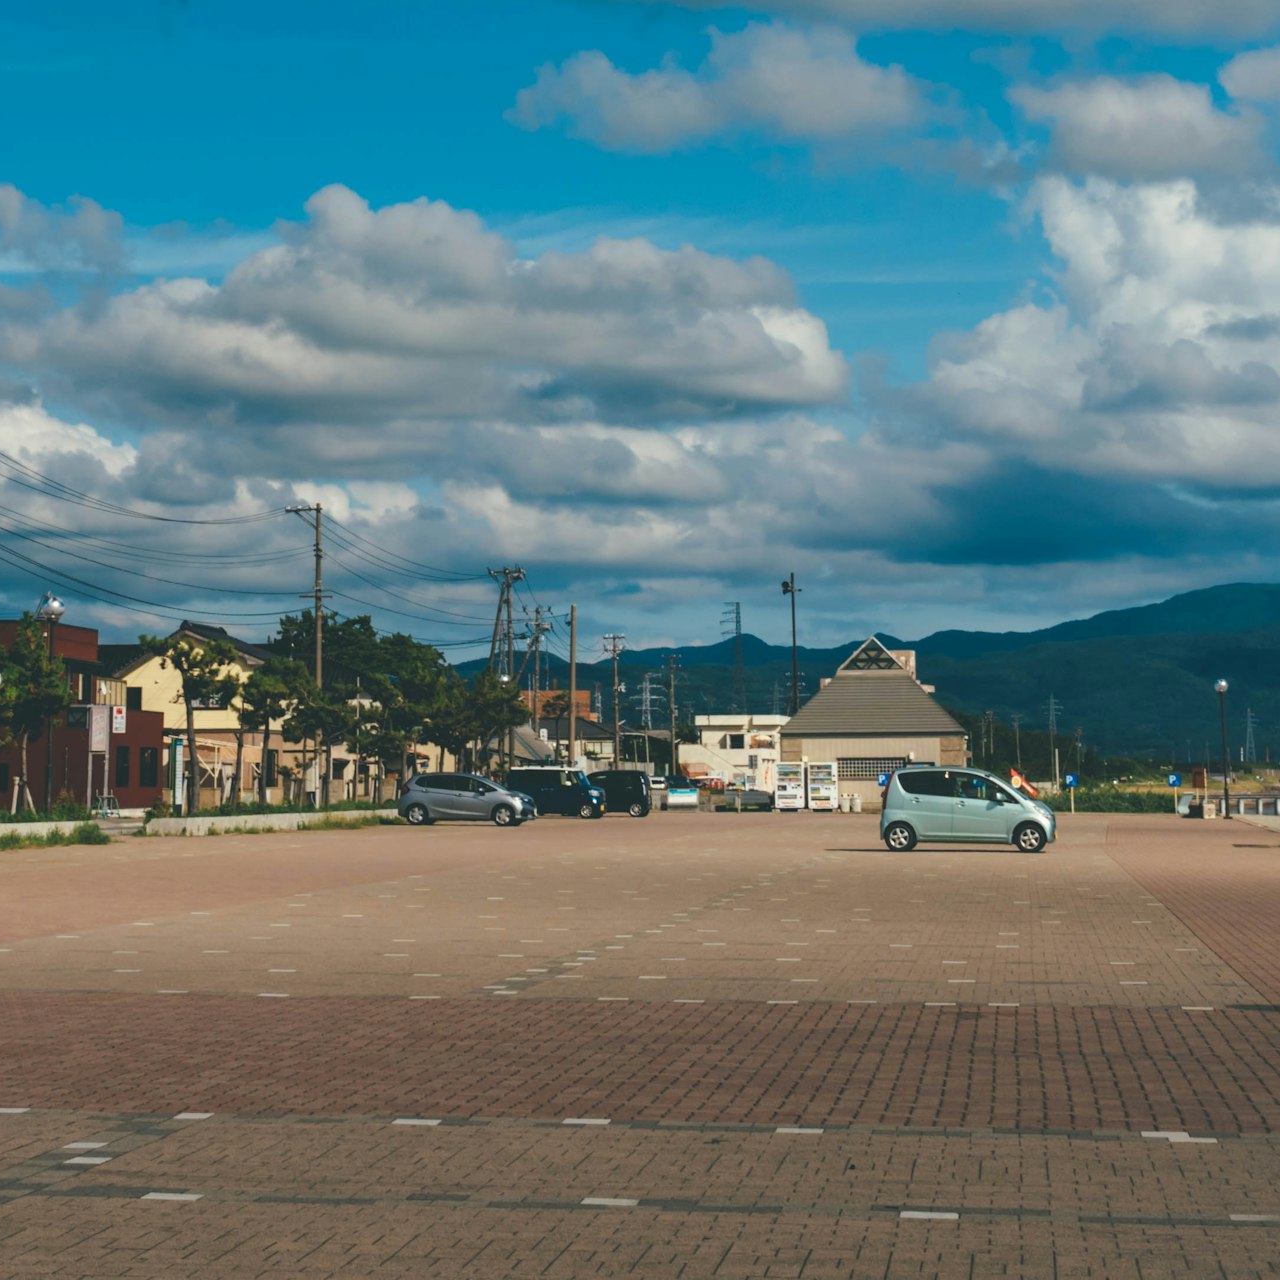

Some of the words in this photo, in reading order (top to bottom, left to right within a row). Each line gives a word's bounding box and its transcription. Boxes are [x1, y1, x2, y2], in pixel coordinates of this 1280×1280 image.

[879, 775, 886, 784] P
[1065, 775, 1073, 784] P
[1169, 775, 1177, 784] P
